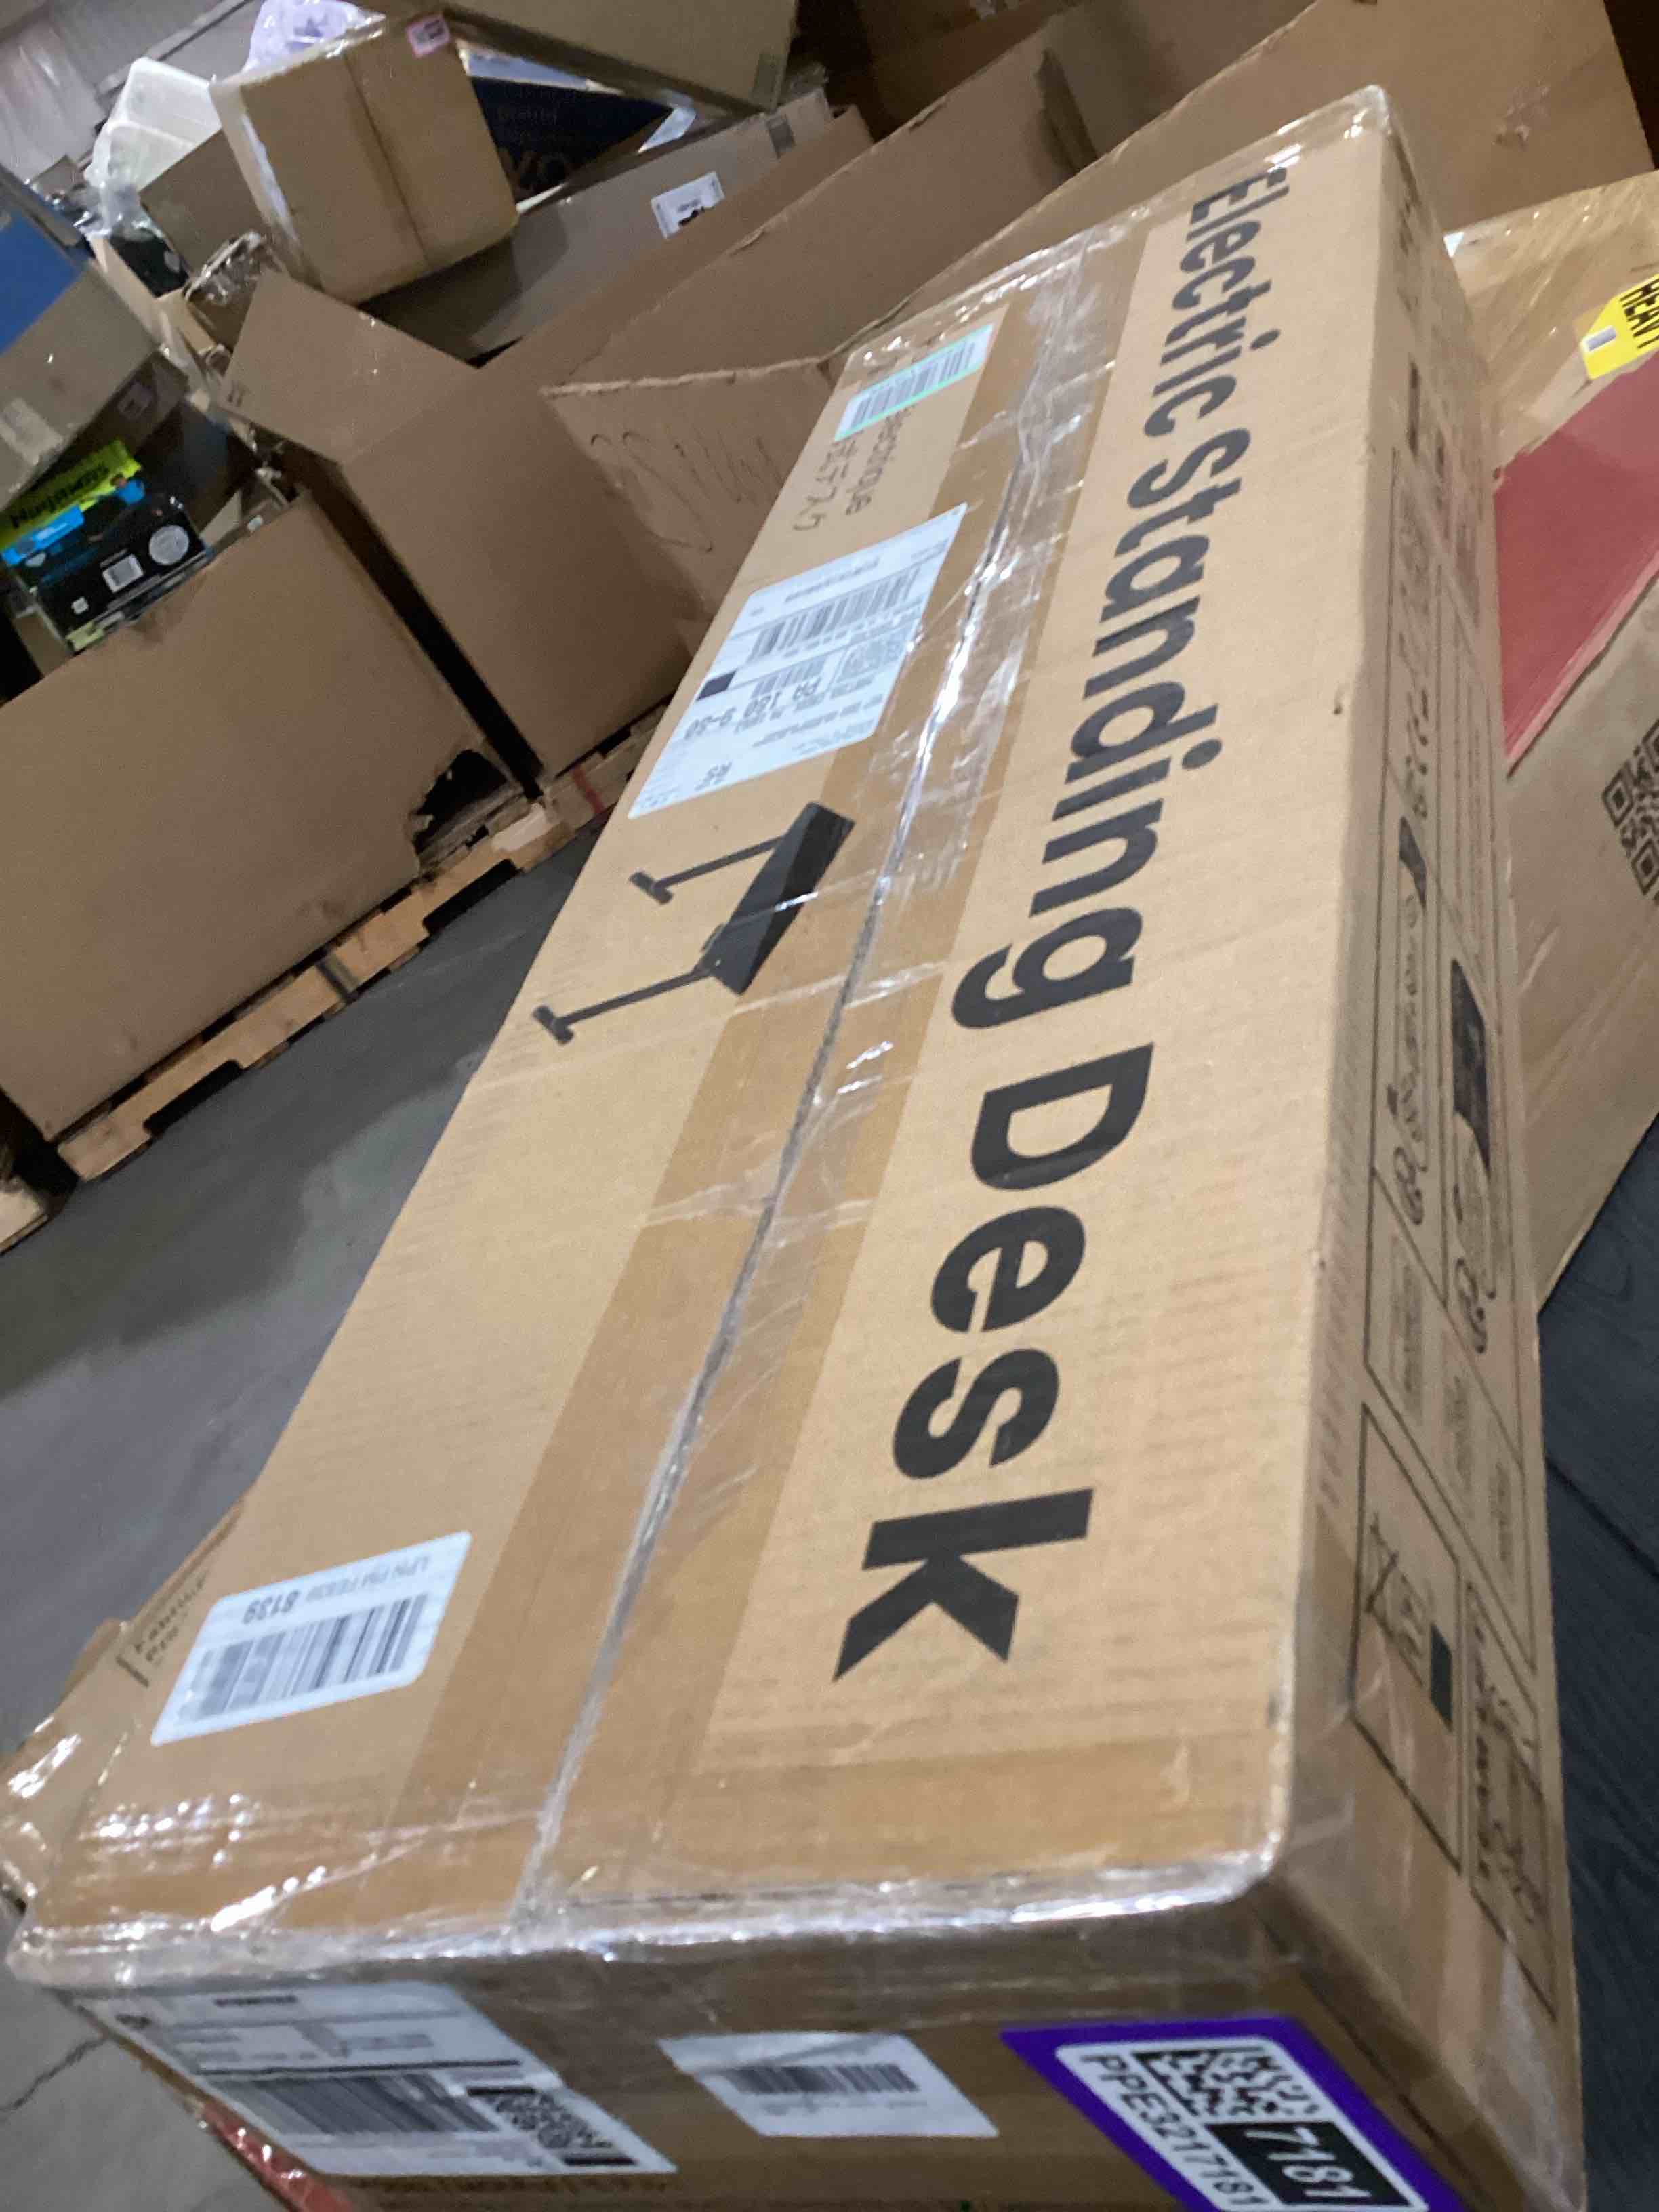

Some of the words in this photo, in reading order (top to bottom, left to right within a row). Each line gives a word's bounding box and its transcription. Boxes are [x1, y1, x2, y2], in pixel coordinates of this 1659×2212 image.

[1144, 167, 1289, 438] Electric
[952, 428, 1251, 1028] Standing
[832, 1041, 1154, 1682] Desk
[242, 1589, 301, 1625] 8139
[1081, 2053, 1269, 2209] PPE3217181
[1245, 2127, 1372, 2202] 7181
